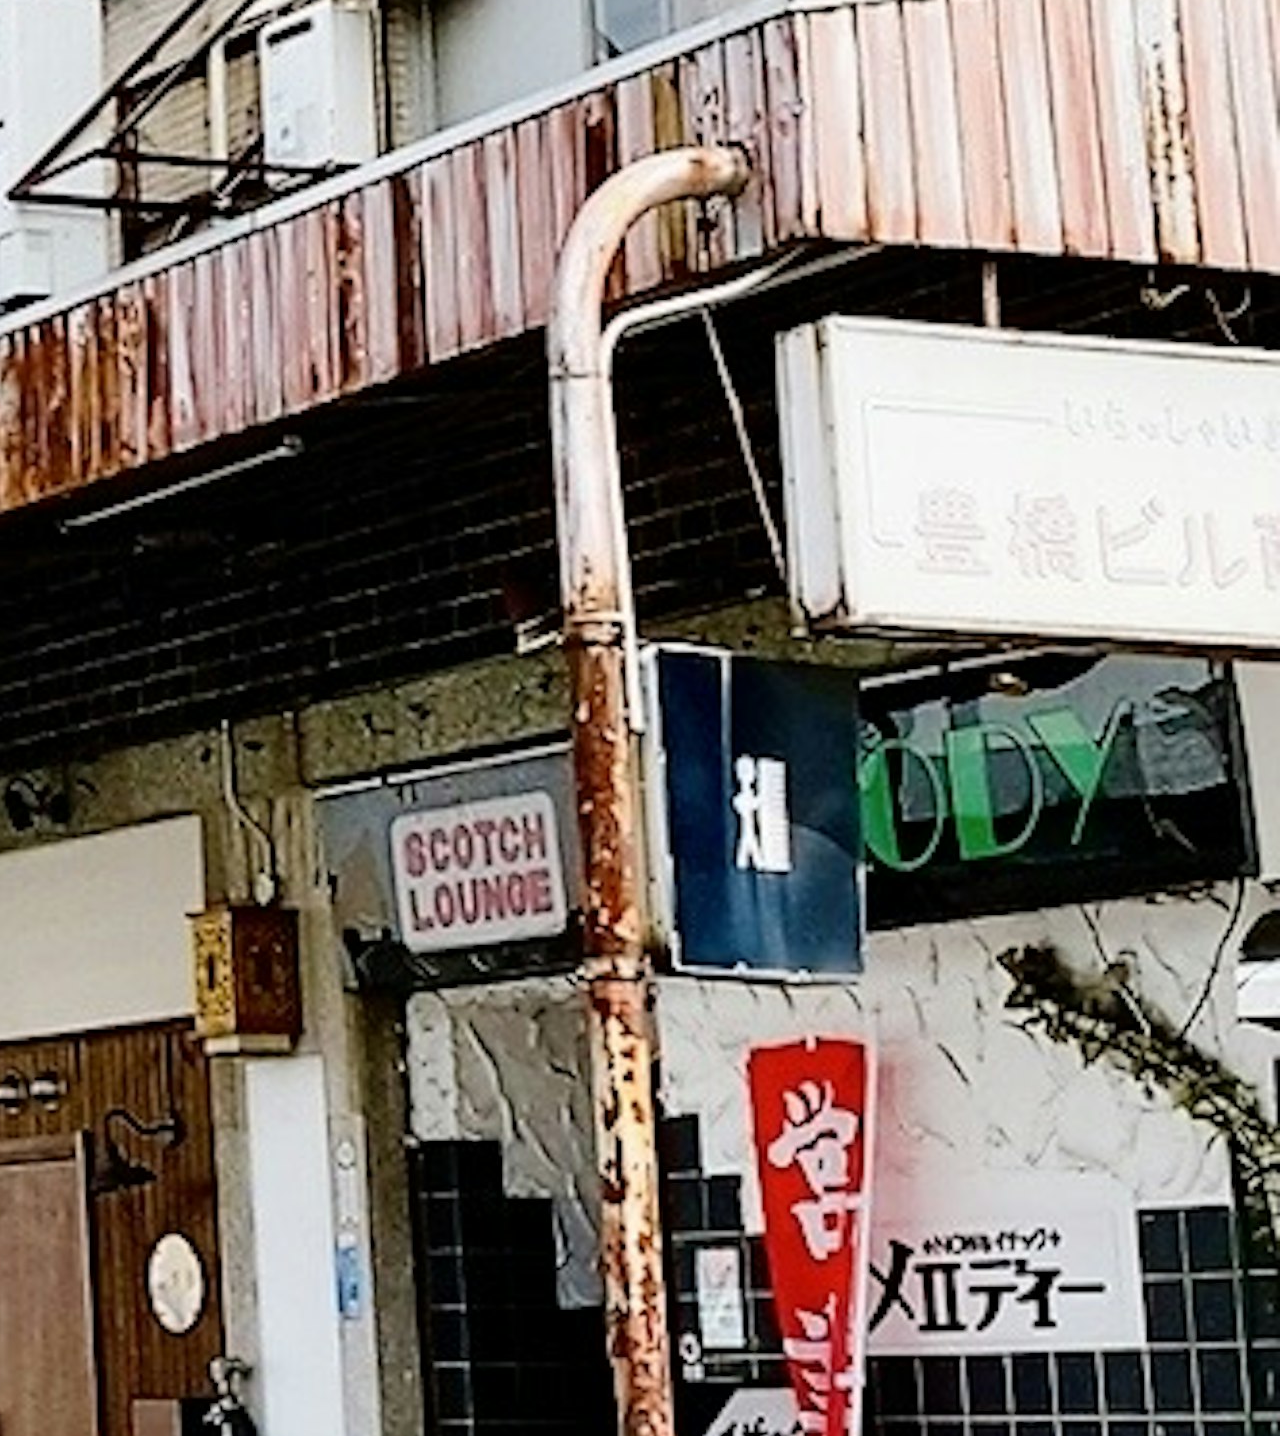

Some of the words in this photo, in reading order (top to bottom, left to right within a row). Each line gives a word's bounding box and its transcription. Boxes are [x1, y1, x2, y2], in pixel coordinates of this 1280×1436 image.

[860, 698, 1134, 872] ODY
[405, 813, 547, 877] SCOTCH
[409, 868, 554, 932] LOUNGE
[868, 1240, 1106, 1334] メロディー
